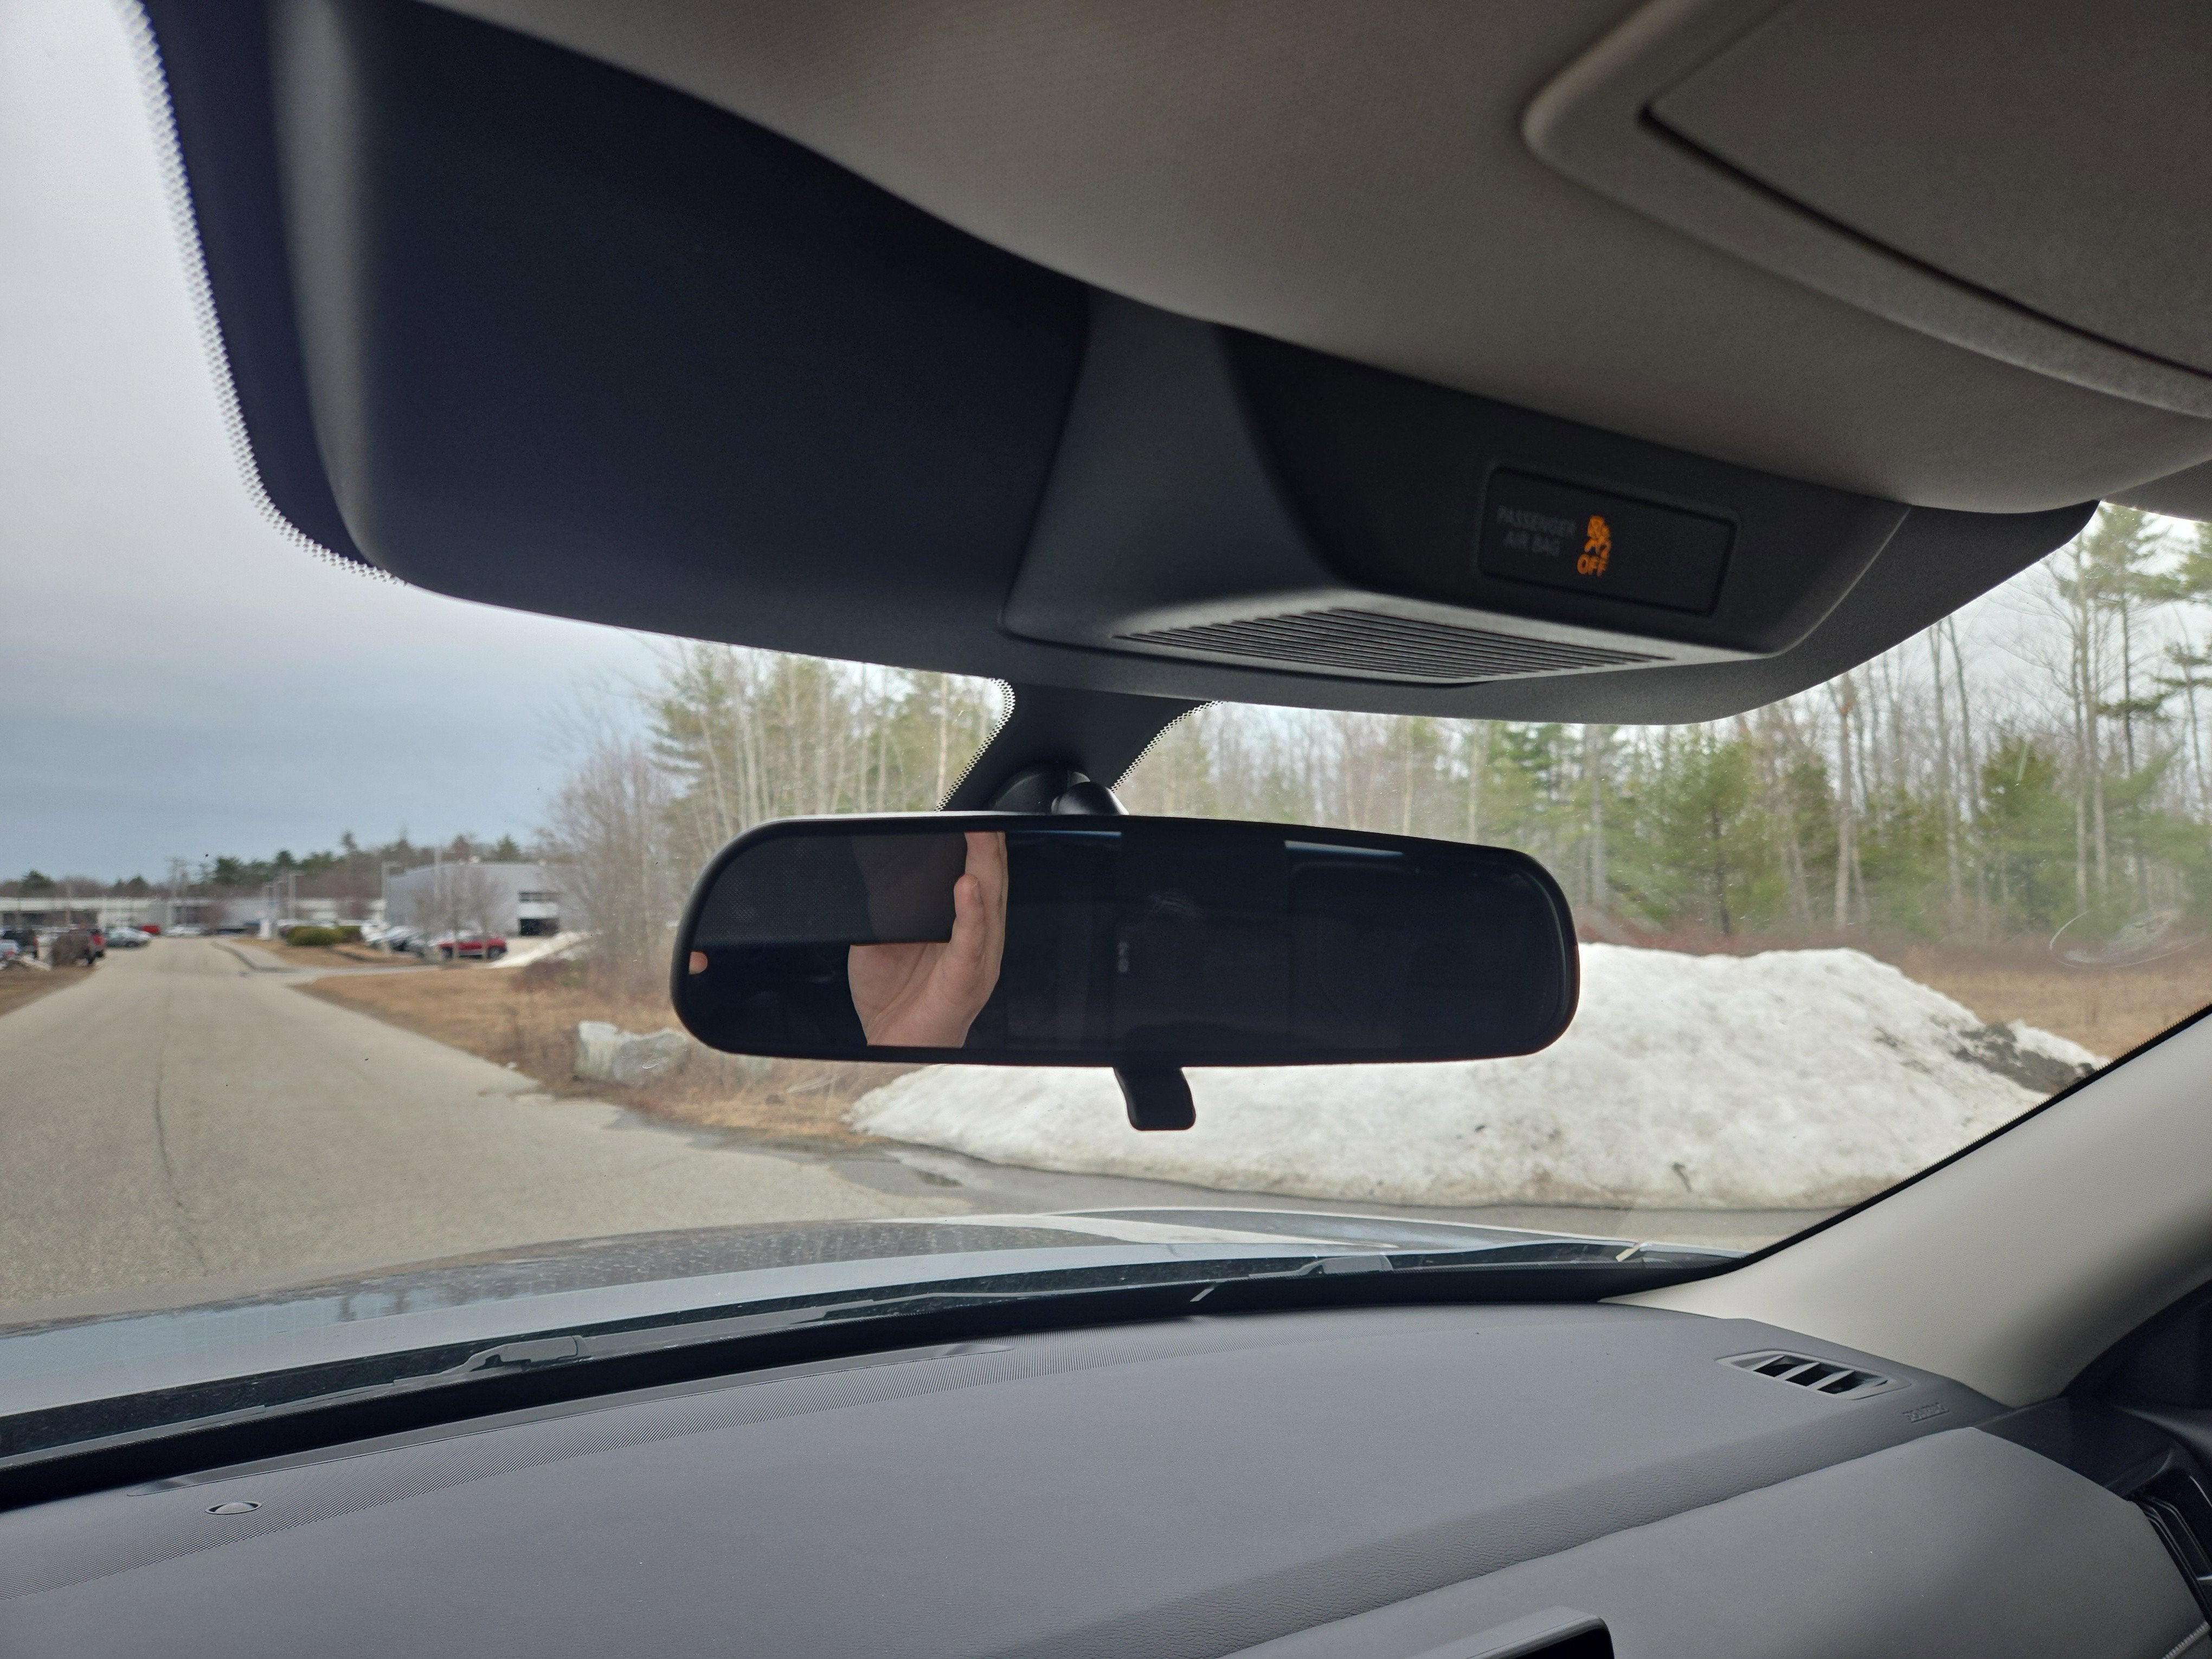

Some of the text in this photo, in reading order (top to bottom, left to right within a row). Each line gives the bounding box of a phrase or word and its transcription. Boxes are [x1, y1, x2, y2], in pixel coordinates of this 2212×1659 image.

[1496, 505, 1577, 539] PASSENGER
[1502, 530, 1560, 557] AIR BAG
[1577, 554, 1608, 576] OFF
